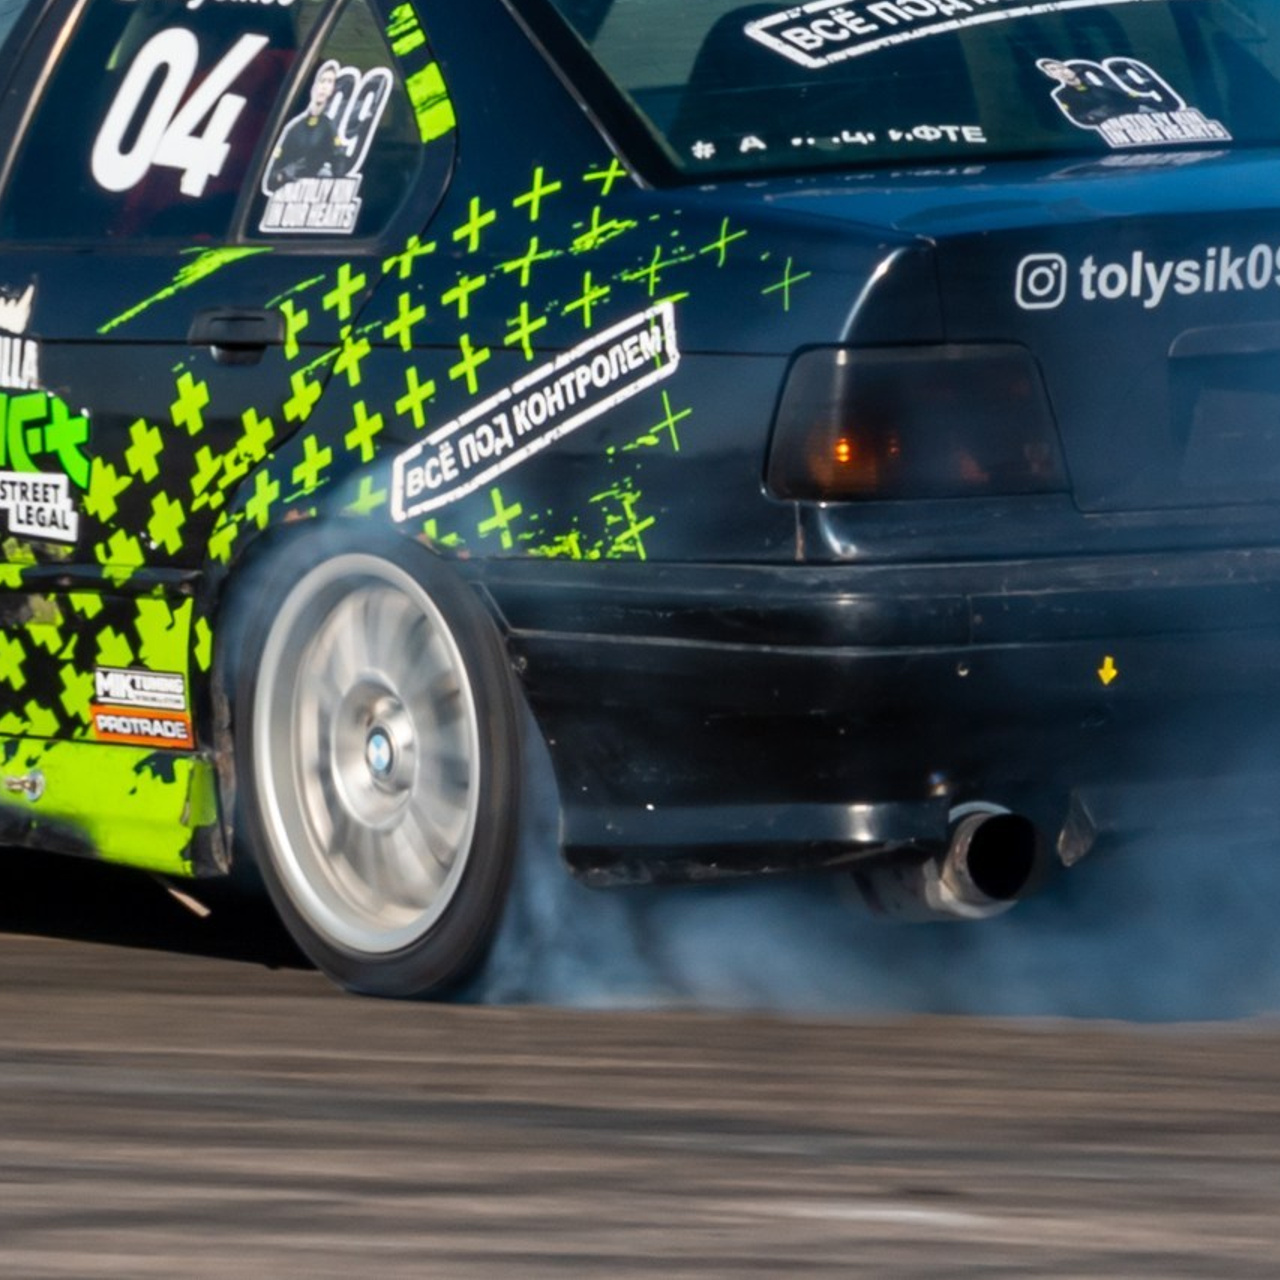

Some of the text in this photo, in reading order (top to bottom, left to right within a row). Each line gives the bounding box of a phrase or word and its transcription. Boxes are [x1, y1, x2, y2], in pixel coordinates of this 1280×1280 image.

[781, 7, 878, 52] ВСЁ
[91, 27, 269, 198] 04
[1080, 243, 1280, 309] tolysik0
[406, 325, 663, 499] ВСЁ ПОД КОНТРОЛЕМ
[0, 480, 60, 504] STREET
[16, 504, 69, 530] LEGAL
[96, 714, 188, 739] PROTRADE
